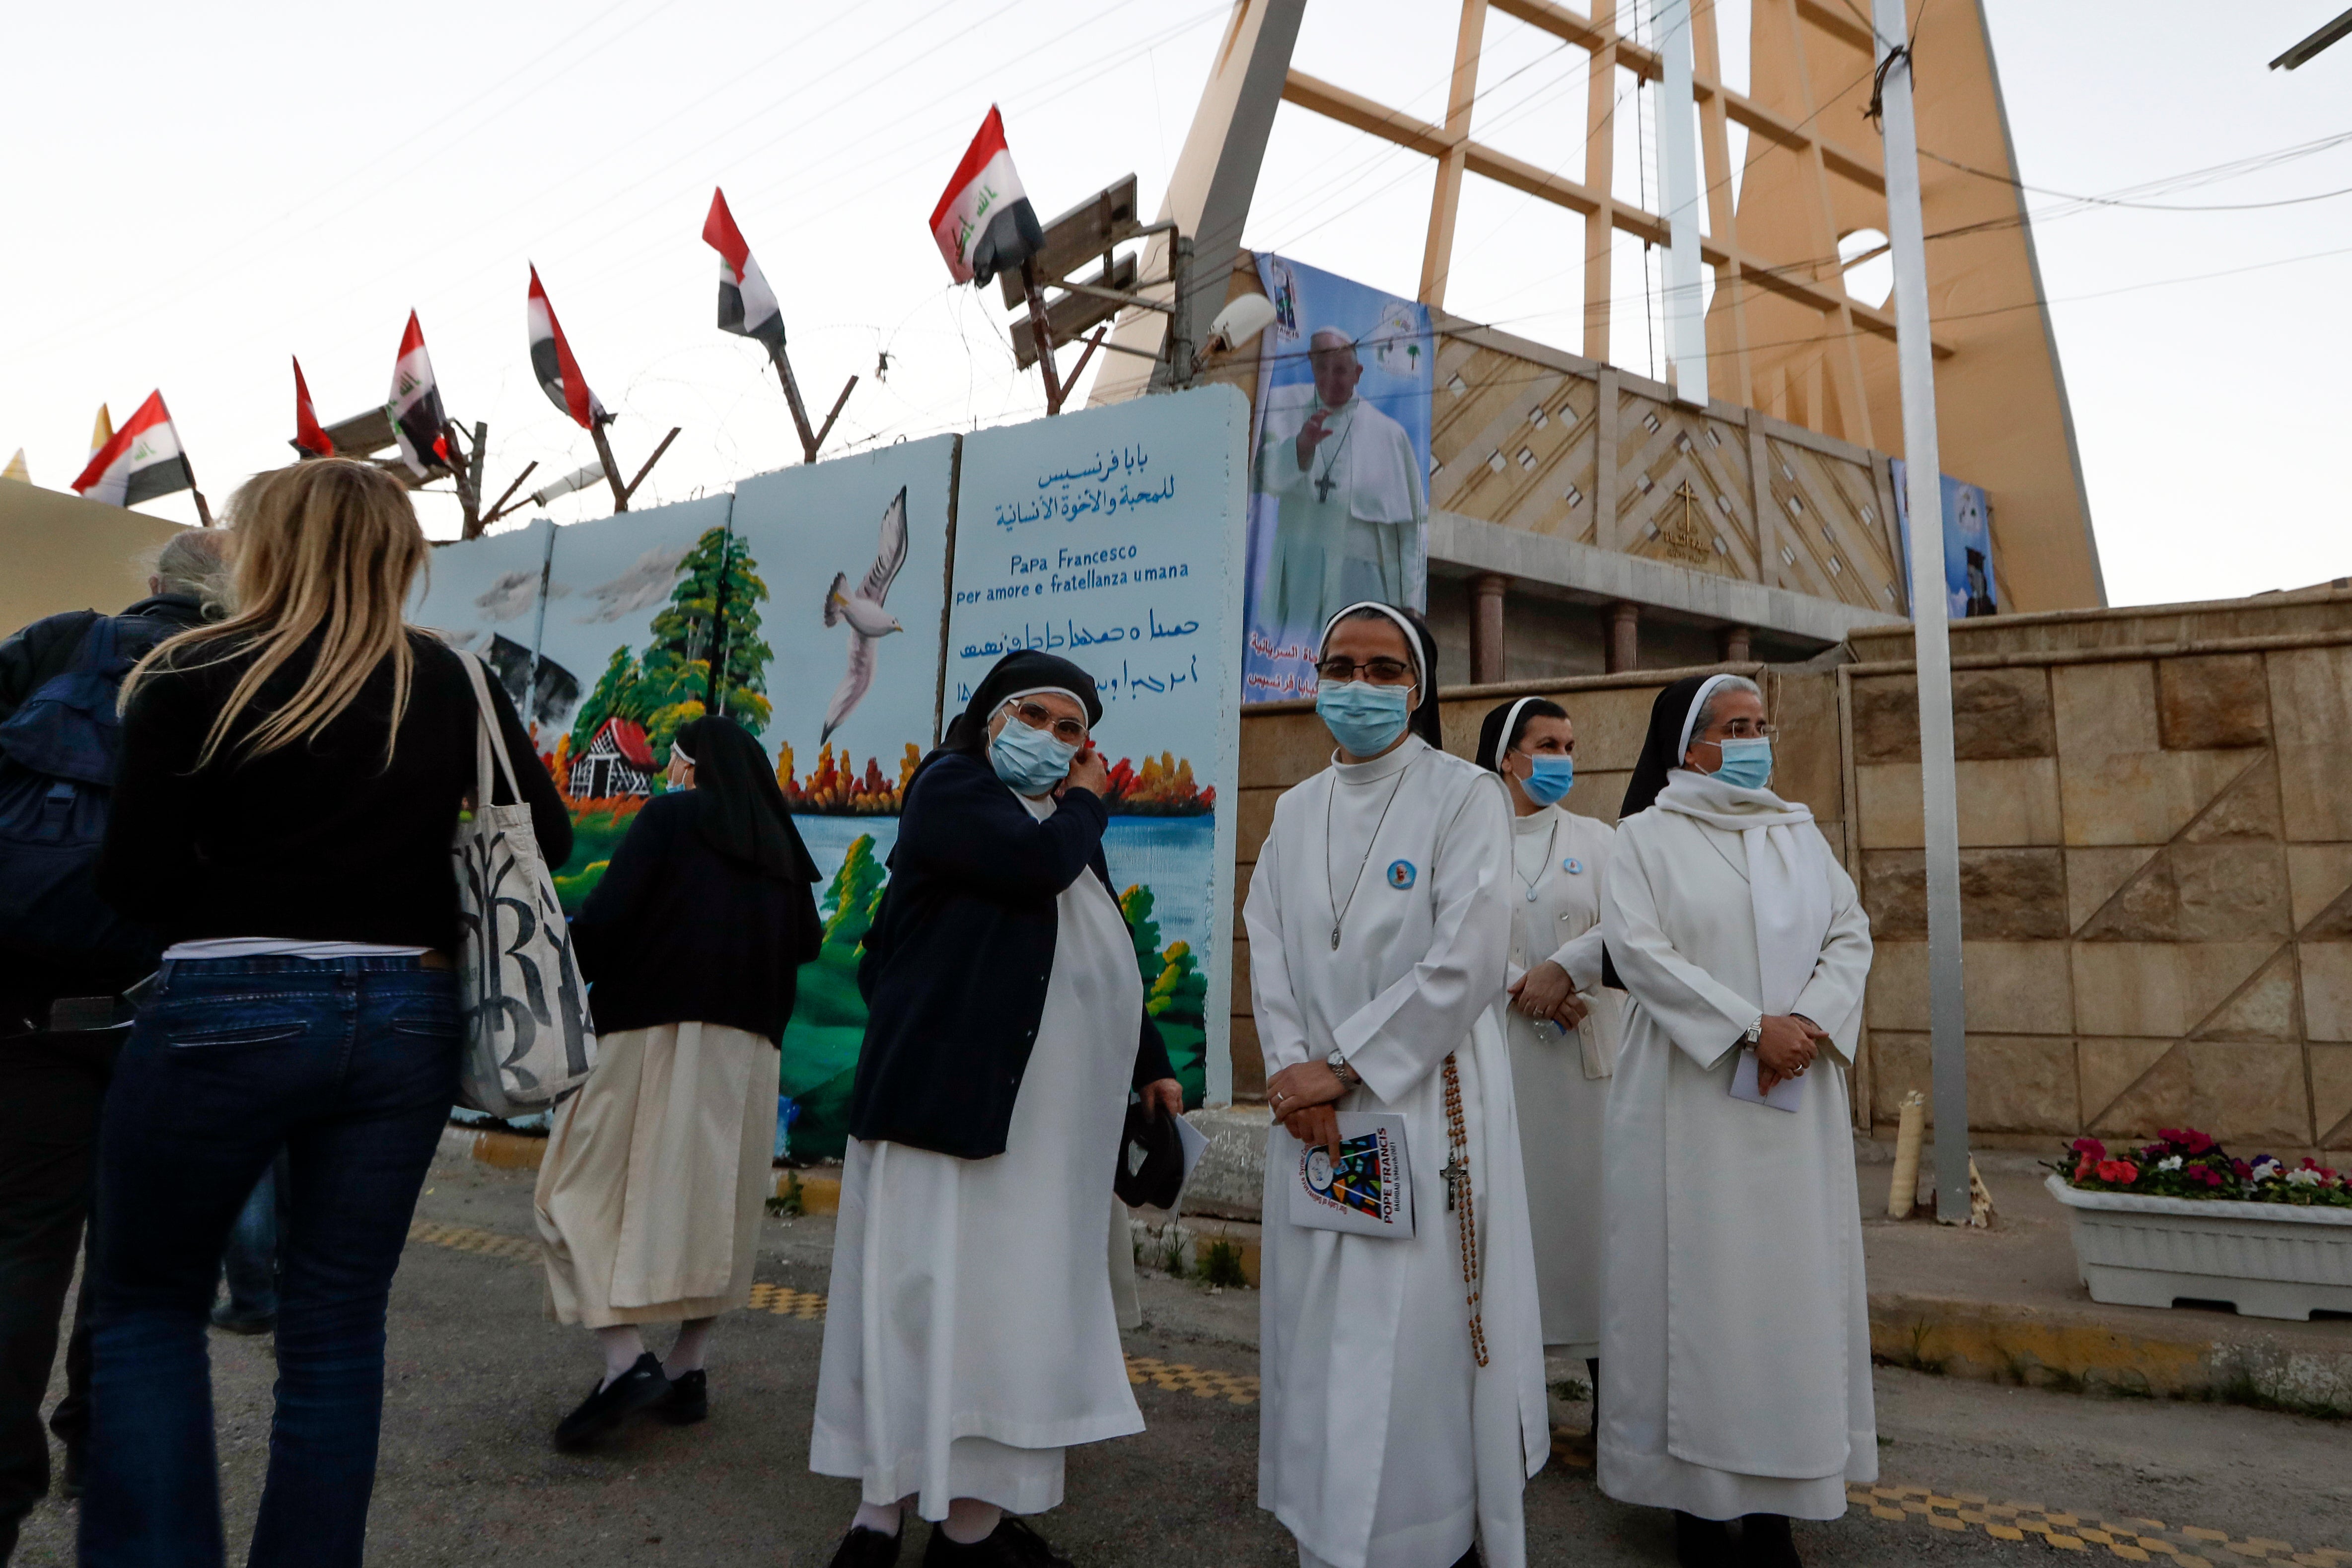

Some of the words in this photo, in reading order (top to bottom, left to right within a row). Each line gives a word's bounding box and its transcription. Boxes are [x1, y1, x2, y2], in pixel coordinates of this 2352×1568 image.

[1038, 449, 1119, 490] فرنسيس
[1124, 443, 1148, 476] بابا
[1119, 473, 1175, 512] للمحبة
[1058, 544, 1137, 569] Francesco
[956, 589, 981, 606] per
[986, 582, 1029, 602] amore
[1034, 582, 1043, 595] e
[1050, 569, 1128, 594] fratellanza
[1134, 563, 1189, 583] umana
[1248, 673, 1295, 693] فرنسيس
[1378, 1127, 1392, 1183] FRANCIS
[1383, 1188, 1393, 1224] POPE
